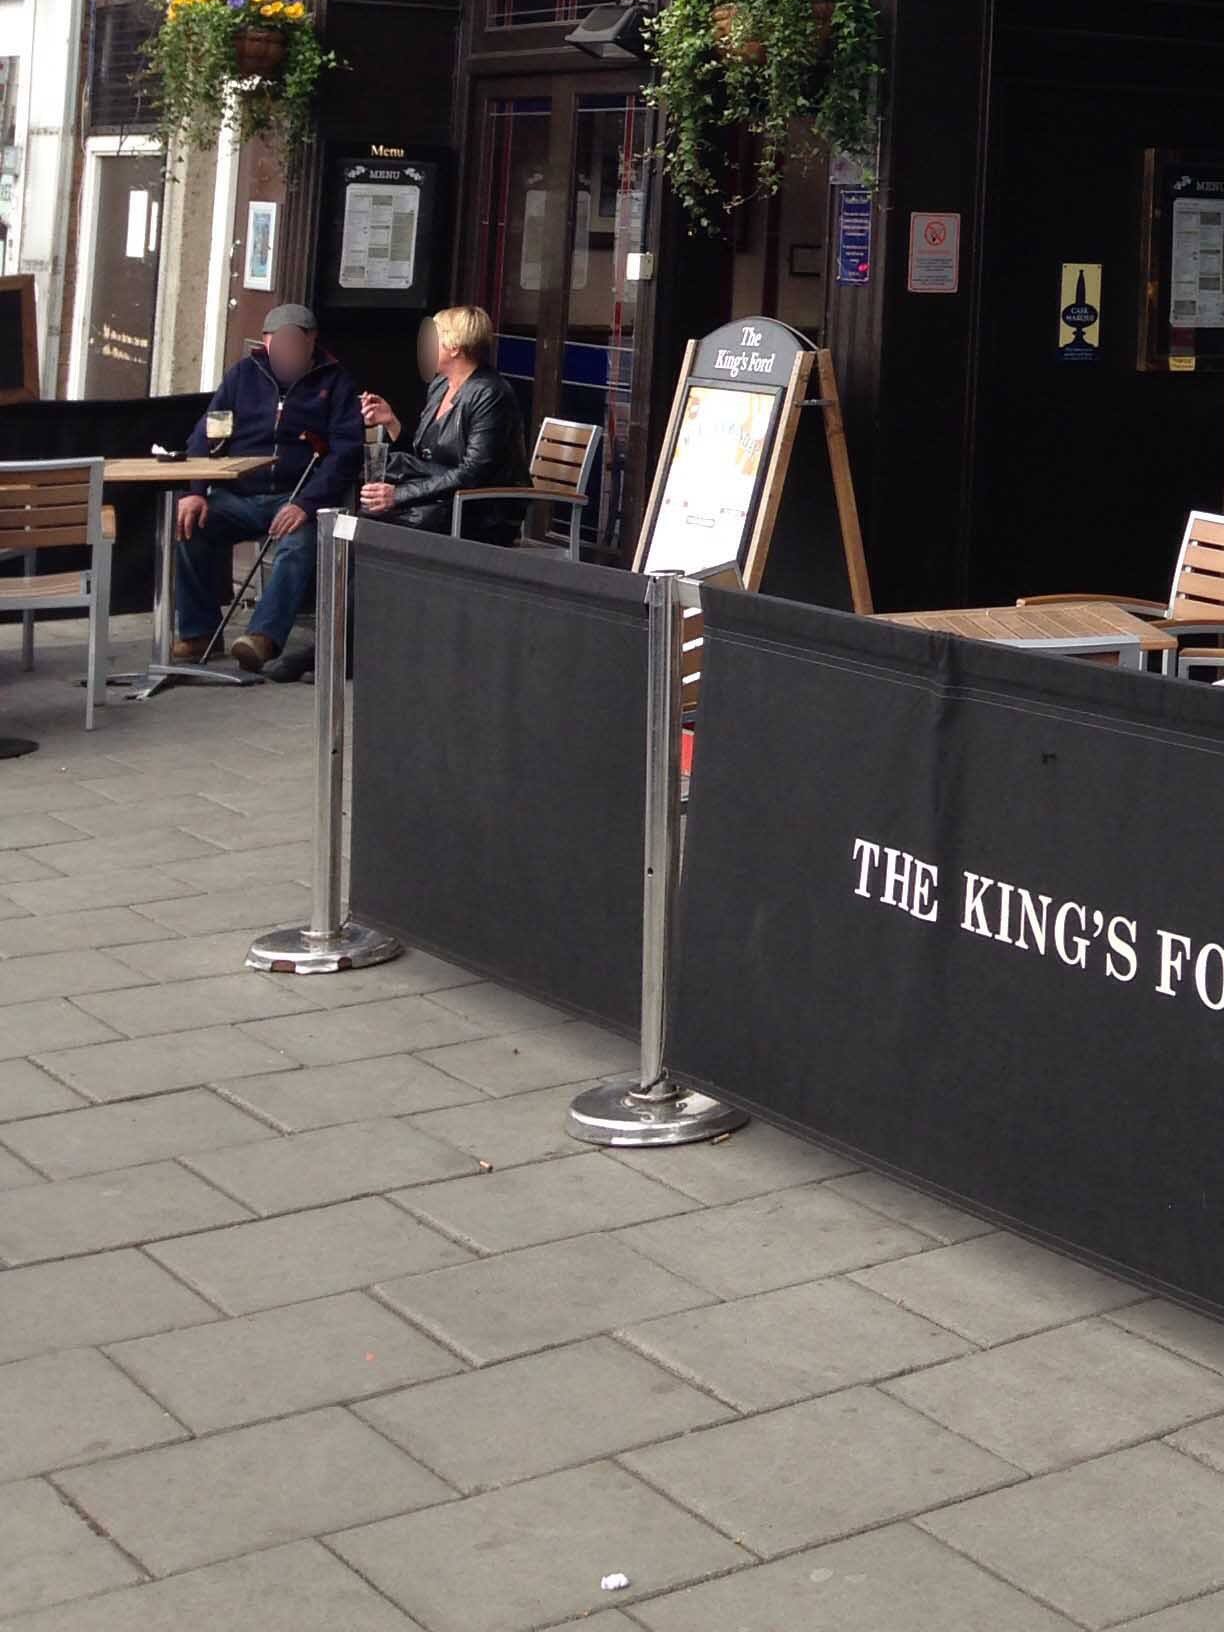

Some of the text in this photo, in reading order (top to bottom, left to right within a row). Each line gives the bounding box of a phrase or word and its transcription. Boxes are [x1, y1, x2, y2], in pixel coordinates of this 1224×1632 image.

[371, 144, 405, 158] Menu
[369, 170, 400, 180] MENU
[740, 326, 763, 348] The
[715, 349, 776, 378] King's Ford
[852, 838, 939, 923] THE
[961, 871, 1138, 982] KING'S
